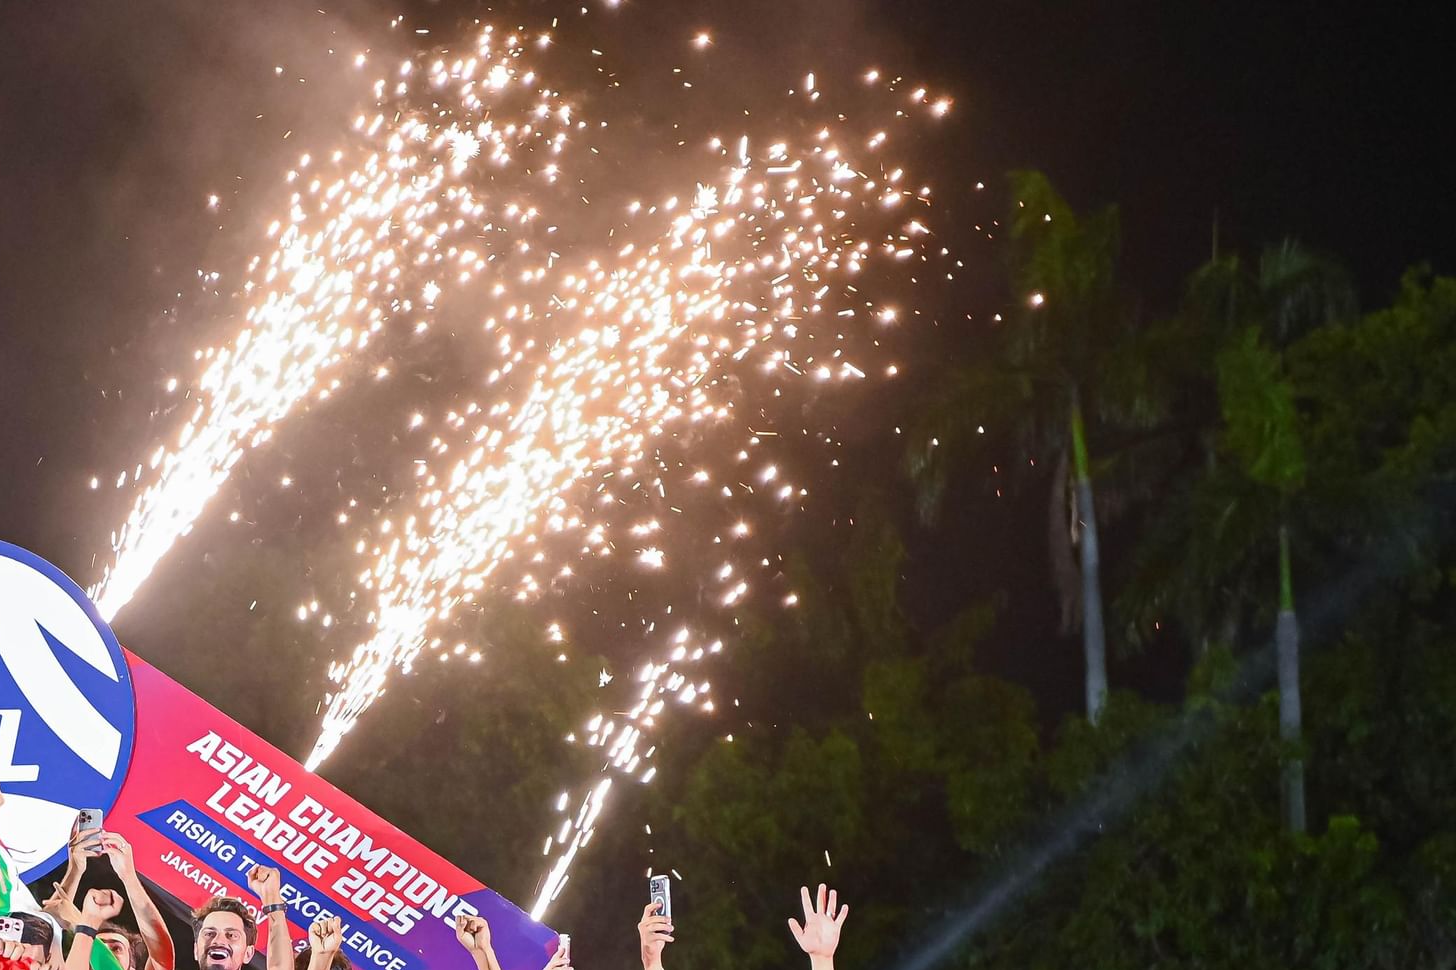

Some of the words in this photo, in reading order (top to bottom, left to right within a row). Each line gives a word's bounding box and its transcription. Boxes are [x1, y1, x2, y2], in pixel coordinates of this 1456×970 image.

[166, 810, 237, 863] RISING
[186, 729, 292, 807] ASIAN
[288, 794, 480, 932] CHAMPIONS
[205, 780, 339, 879] LEAGUE
[331, 867, 424, 936] 2025
